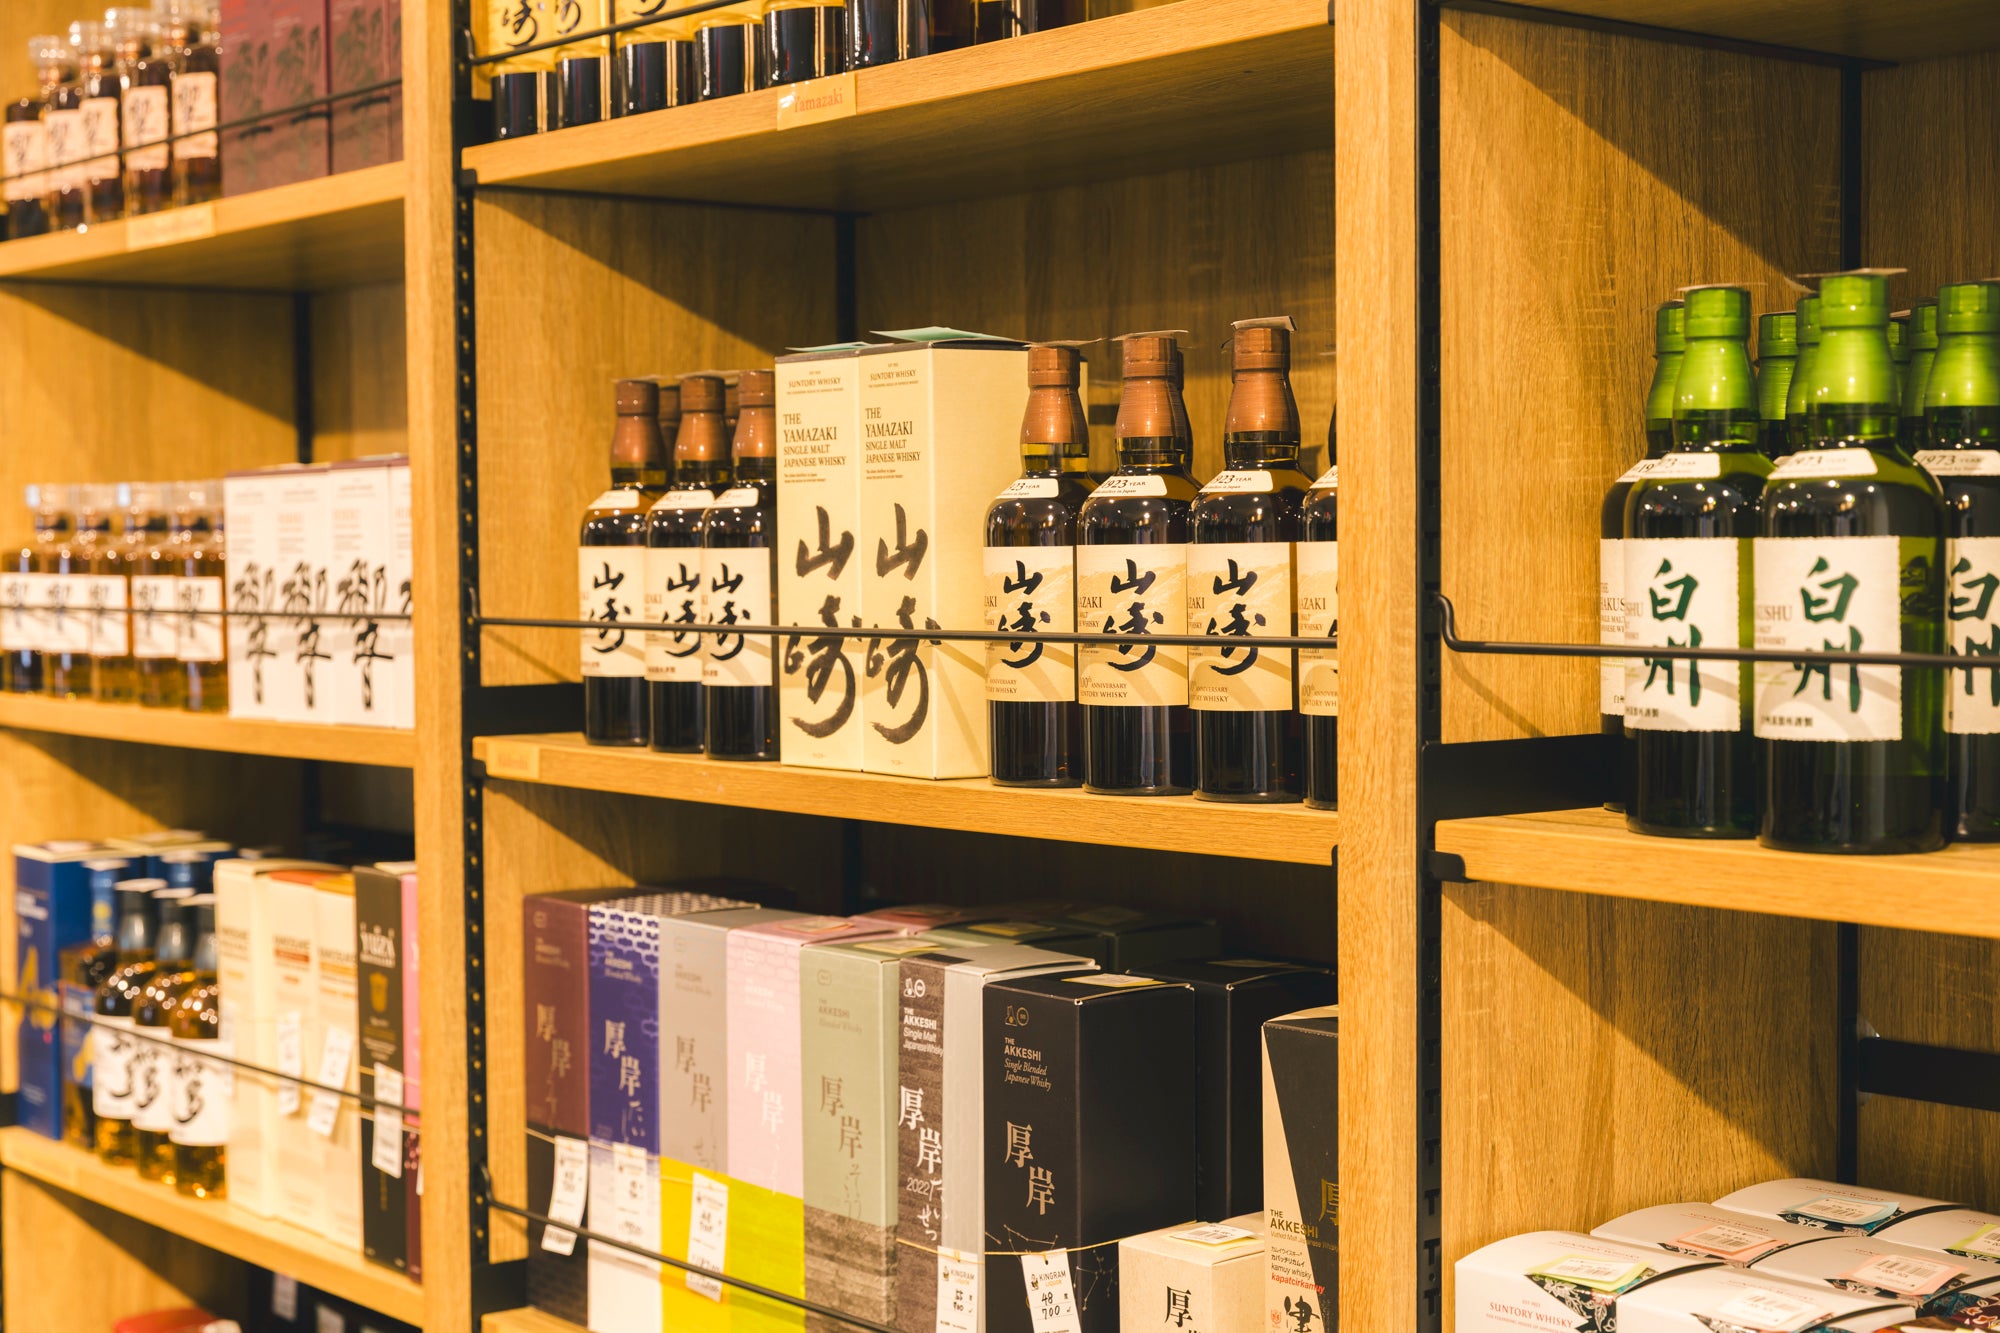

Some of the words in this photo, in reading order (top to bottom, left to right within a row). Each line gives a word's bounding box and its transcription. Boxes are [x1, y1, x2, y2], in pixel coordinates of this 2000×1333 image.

[783, 413, 801, 425] THE
[865, 407, 881, 420] THE
[783, 426, 837, 443] YAMAZAKI
[865, 421, 913, 438] YAMAZAKI
[784, 444, 808, 455] SINGLE
[810, 444, 830, 454] MALT
[866, 440, 888, 451] SINGLE
[889, 439, 907, 449] MALT
[784, 457, 817, 468] JAPANESE
[818, 456, 846, 466] WHISKY
[866, 453, 895, 464] JAPANESE
[896, 451, 921, 462] WHISKY
[1920, 455, 1956, 466] 1973
[784, 505, 862, 738] 山崎
[998, 560, 1051, 669] 山崎
[1102, 558, 1164, 672] 山崎
[1206, 558, 1266, 676] 山崎
[866, 503, 942, 744] 山崎
[1643, 557, 1703, 707] 白州
[1793, 556, 1864, 713] 白州
[1203, 695, 1229, 703] WHISKY
[903, 1015, 937, 1030] AKKESHI
[903, 1027, 923, 1041] Single
[923, 1031, 937, 1042] Malt
[1004, 1037, 1015, 1045] THE
[604, 1019, 641, 1097] 厚岸
[1004, 1045, 1041, 1062] AKKESHI
[676, 1035, 712, 1113] 厚岸
[1004, 1058, 1022, 1073] Single
[1023, 1061, 1048, 1075] Blended
[1004, 1070, 1030, 1085] Japanese
[1030, 1075, 1052, 1092] Whisky
[744, 1051, 784, 1134] 厚岸
[820, 1075, 863, 1159] 厚岸
[898, 1085, 943, 1174] 厚岸
[1005, 1120, 1055, 1216] 厚岸
[906, 1177, 930, 1195] 2022
[1270, 1209, 1283, 1218] THE
[1270, 1218, 1319, 1239] AKKESHI
[1039, 1270, 1066, 1281] KINGRAM
[1271, 1263, 1291, 1275] kamuy
[1292, 1268, 1312, 1280] whisky
[1271, 1272, 1325, 1295] kapatcirkamuy
[1041, 1291, 1053, 1306] 48
[1041, 1305, 1061, 1320] 700
[1490, 1302, 1533, 1319] SUNTORY
[1535, 1312, 1573, 1328] WHISKY
